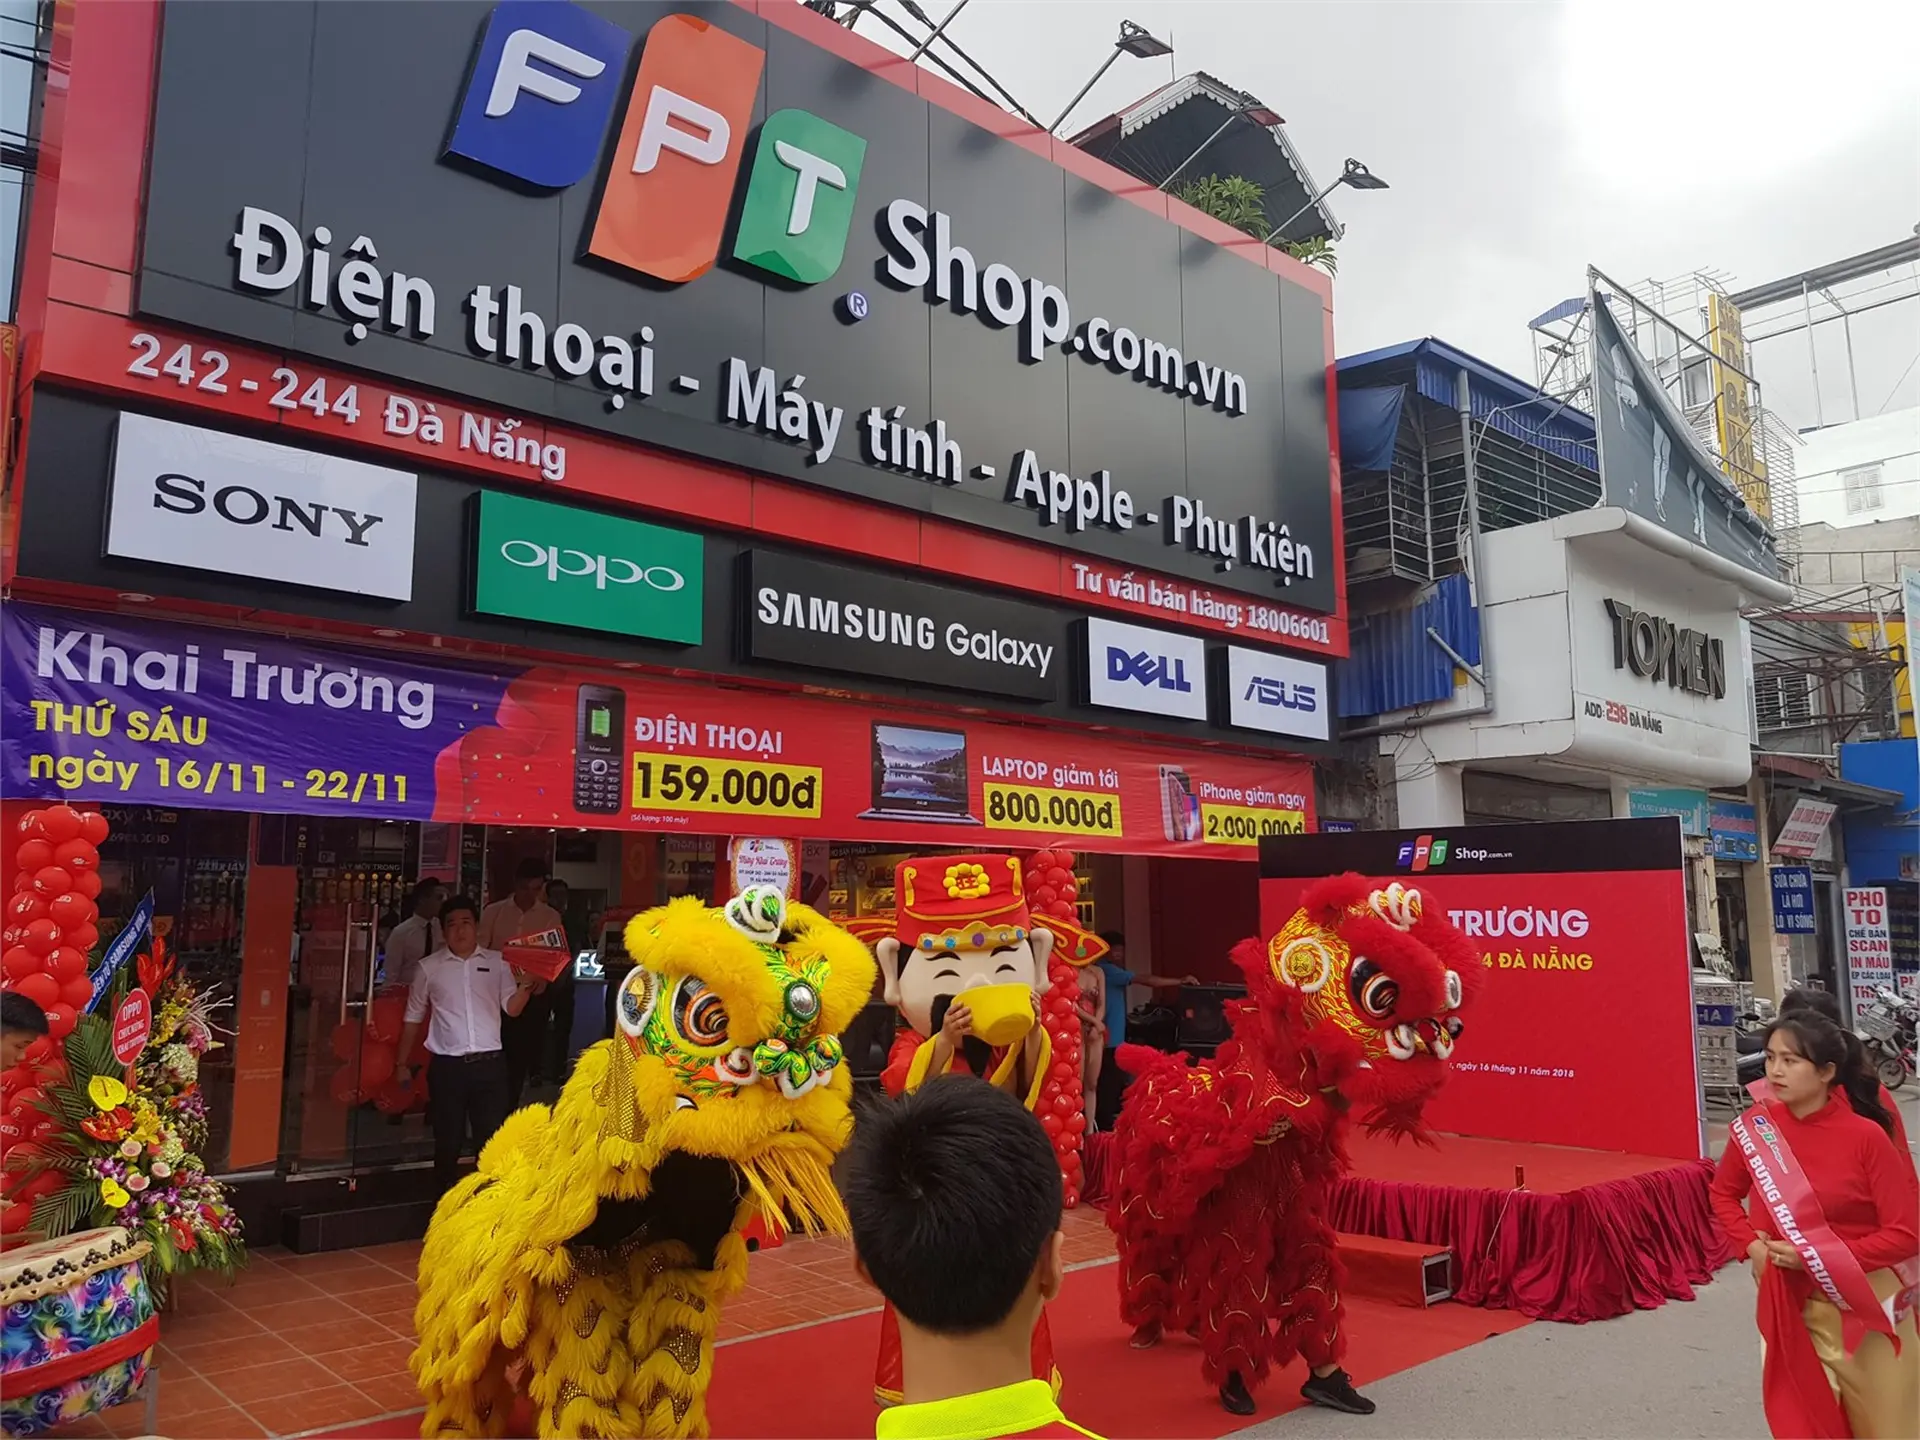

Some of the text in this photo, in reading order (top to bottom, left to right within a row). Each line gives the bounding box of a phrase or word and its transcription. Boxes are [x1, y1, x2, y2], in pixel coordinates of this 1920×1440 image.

[484, 27, 848, 236] FPT
[885, 197, 1248, 415] Shop.com.vn
[126, 332, 229, 395] 242
[268, 367, 360, 424] 244
[382, 394, 445, 445] Đà
[459, 411, 567, 482] Nẵng
[233, 204, 436, 341] Điện
[471, 284, 655, 410] thoại
[727, 355, 843, 465] Máy
[867, 406, 963, 483] tính
[1014, 448, 1134, 533] Apple
[1172, 495, 1237, 572] Phụ
[1248, 515, 1315, 586] kiện
[152, 472, 383, 547] SONY
[1072, 562, 1330, 645] Tư vấn bán hàng: 18006601
[757, 586, 1054, 679] SAMSUNG Galaxy
[37, 626, 435, 730] Khai Trương
[1106, 646, 1192, 693] DELL
[1243, 675, 1317, 713] ASUS
[30, 697, 208, 746] THỨ SÁU
[634, 712, 783, 760] ĐIỆN THOẠI
[29, 750, 140, 791] ngày
[156, 757, 267, 795] 16/11
[305, 769, 408, 803] 22/11
[637, 761, 817, 810] 159.000đ
[982, 755, 1121, 789] LAPTOP giảm tới
[988, 789, 1114, 831] 800.000đ
[1199, 781, 1307, 810] iPhone giảm ngay
[1846, 891, 1885, 907] PHO
[1851, 909, 1882, 926] TO
[1447, 905, 1590, 939] TRƯƠNG
[109, 927, 138, 968] SAMSUNG
[1498, 948, 1527, 969] ĐÀ
[1533, 945, 1594, 971] NẴNG
[1849, 940, 1888, 952] SCAN
[1850, 956, 1863, 969] IN
[122, 999, 143, 1022] OPPO
[1456, 1061, 1478, 1072] ngày
[1480, 1063, 1490, 1072] 16
[1491, 1063, 1516, 1075] tháng
[1518, 1066, 1528, 1075] 11
[1552, 1068, 1575, 1078] 2018
[1773, 1200, 1808, 1247] KHAI
